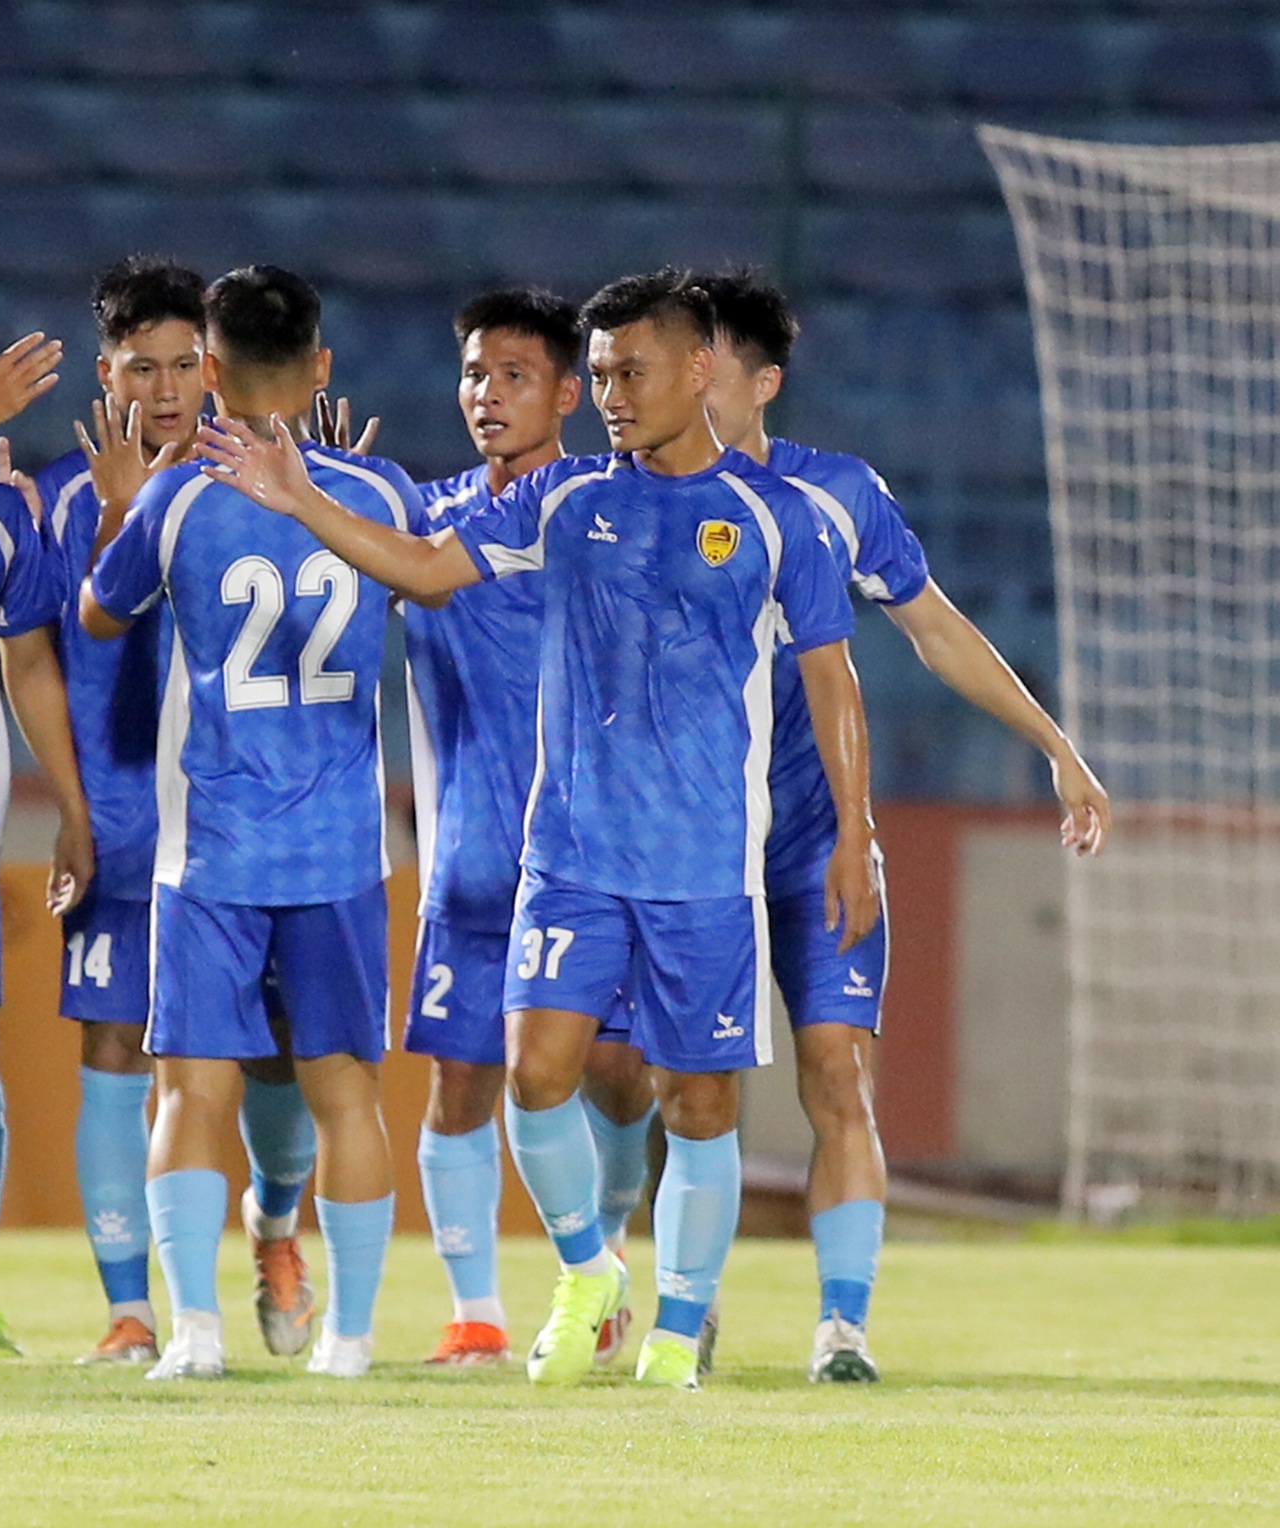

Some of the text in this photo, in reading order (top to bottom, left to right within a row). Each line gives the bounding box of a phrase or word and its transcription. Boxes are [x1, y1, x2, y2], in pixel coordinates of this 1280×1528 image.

[221, 549, 359, 712] 22
[66, 931, 112, 988] 14
[517, 926, 575, 980] 37
[421, 963, 454, 1019] 2
